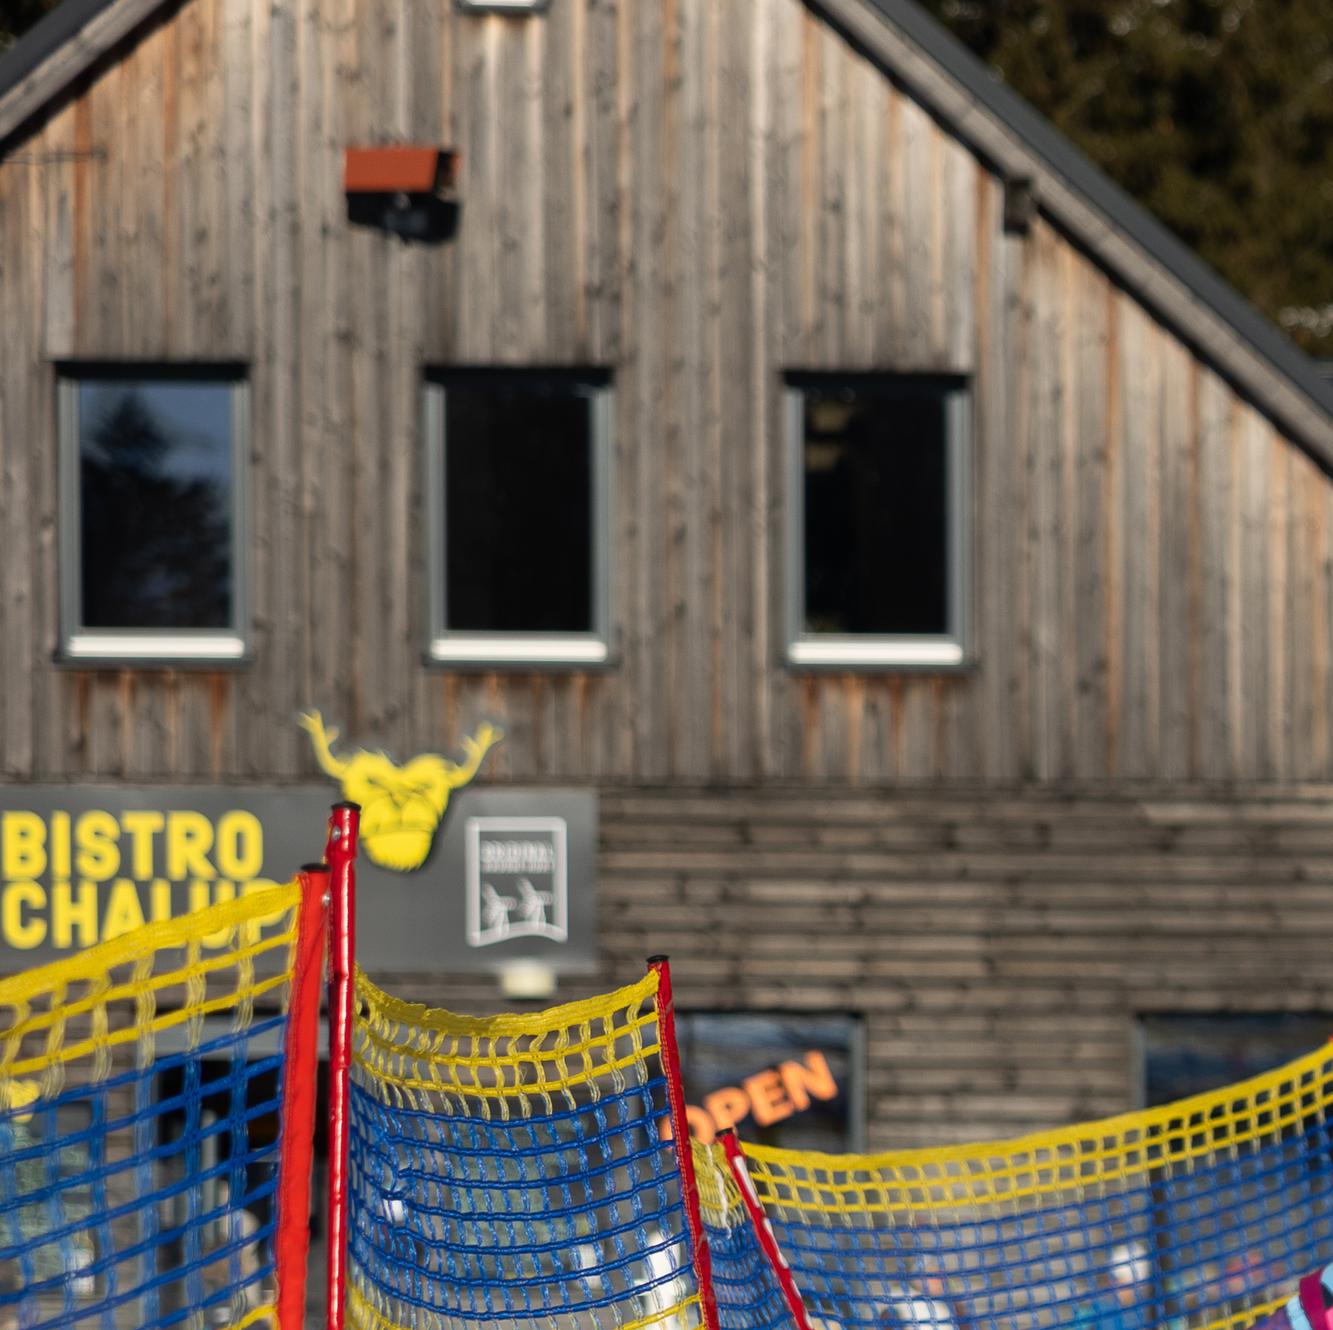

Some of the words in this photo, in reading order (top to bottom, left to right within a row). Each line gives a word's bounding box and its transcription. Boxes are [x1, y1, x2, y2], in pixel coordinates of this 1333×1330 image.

[2, 809, 264, 882] BISTRO
[2, 877, 291, 950] CHALUP
[659, 1049, 838, 1150] OPEN
